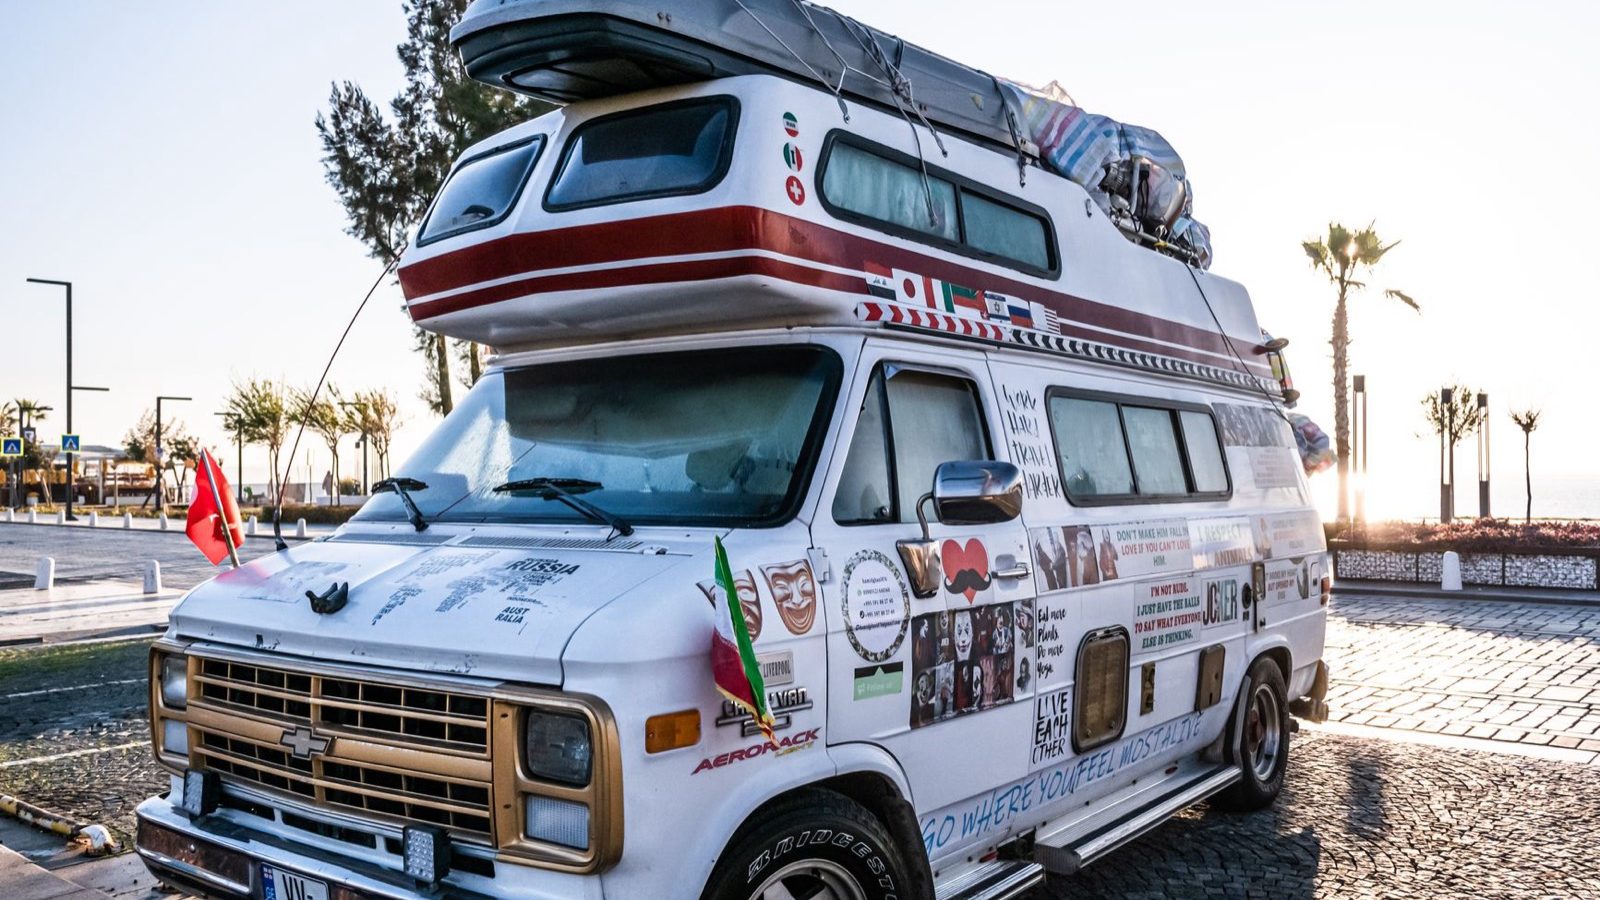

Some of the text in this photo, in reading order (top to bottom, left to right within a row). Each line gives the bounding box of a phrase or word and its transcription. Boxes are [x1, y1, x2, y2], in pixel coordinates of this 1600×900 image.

[1138, 527, 1155, 540] MAKE
[1156, 526, 1168, 539] HIM
[1121, 543, 1138, 556] LOVE
[1145, 541, 1158, 553] YOU
[505, 559, 581, 575] RUSSIA
[1160, 583, 1172, 596] NOT
[501, 605, 531, 616] AUST
[1141, 602, 1156, 616] JUST
[1156, 600, 1172, 614] HAVE
[1173, 598, 1184, 610] THE
[1185, 596, 1200, 608] BALLS
[1202, 579, 1238, 626] JOKER
[495, 613, 524, 624] RALIA
[1038, 606, 1066, 623] Eat more
[1135, 611, 1201, 634] TO SAY WHAT EVERYONE
[1142, 634, 1157, 649] ELSE
[1157, 633, 1164, 646] IS
[1037, 644, 1063, 660] Do more
[763, 660, 791, 678] LIVERPOOL
[1037, 691, 1068, 721] LIVE
[1035, 713, 1068, 745] EACH
[1032, 737, 1065, 765] OTHER
[921, 715, 1203, 857] GO WHERE YOU FEEL MOST ALIVE
